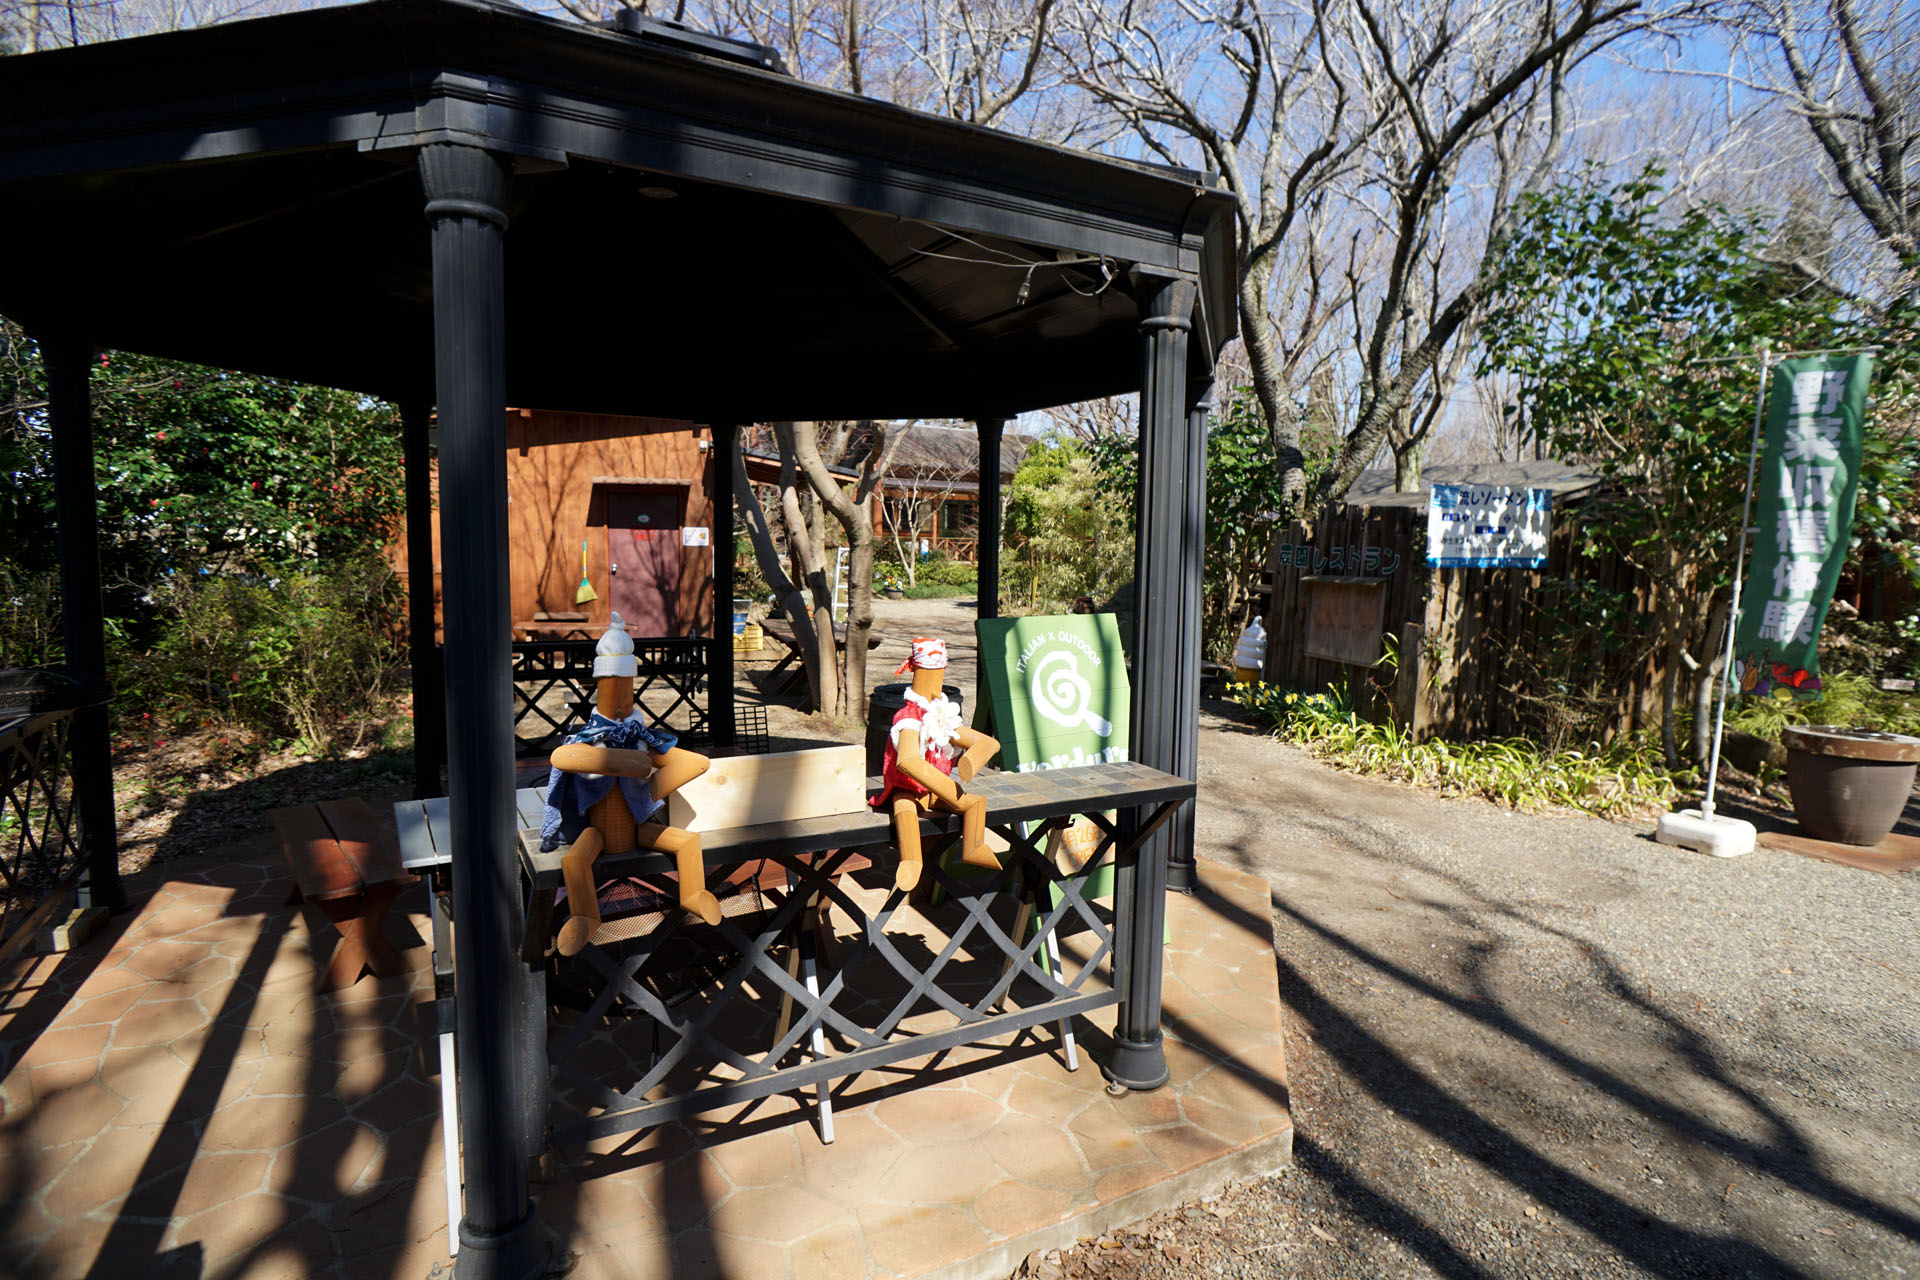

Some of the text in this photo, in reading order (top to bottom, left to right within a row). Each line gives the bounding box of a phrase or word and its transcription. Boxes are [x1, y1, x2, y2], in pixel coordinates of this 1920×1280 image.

[1758, 370, 1848, 646] 野菜収穫体験
[1280, 544, 1400, 575] 農園レストラン
[1016, 633, 1046, 673] ITALIAN
[1057, 630, 1102, 668] OUTDOOR
